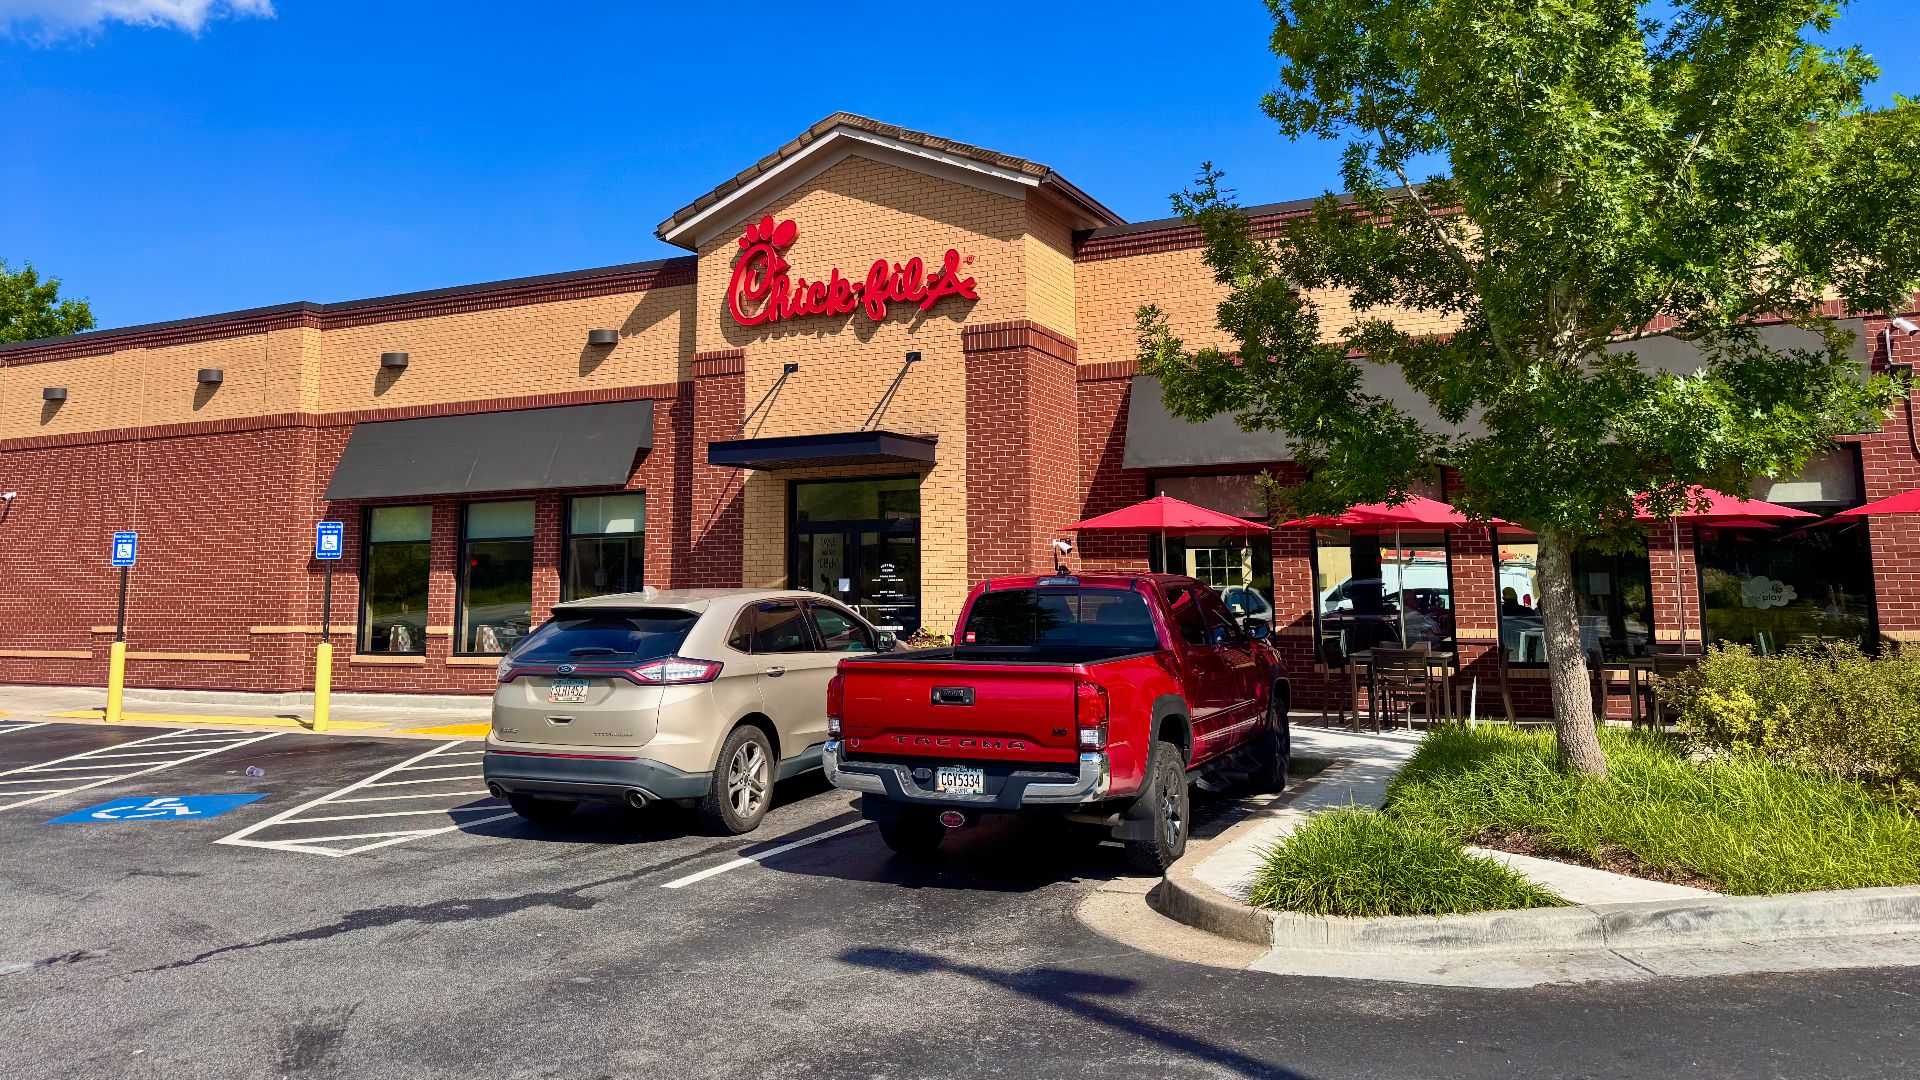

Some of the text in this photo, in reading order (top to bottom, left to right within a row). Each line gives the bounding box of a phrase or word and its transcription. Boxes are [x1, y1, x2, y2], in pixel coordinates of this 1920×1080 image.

[729, 240, 980, 325] Chick-fil-A
[1762, 593, 1782, 602] play
[892, 735, 1026, 750] TACOMA
[941, 772, 980, 788] CGY5334
